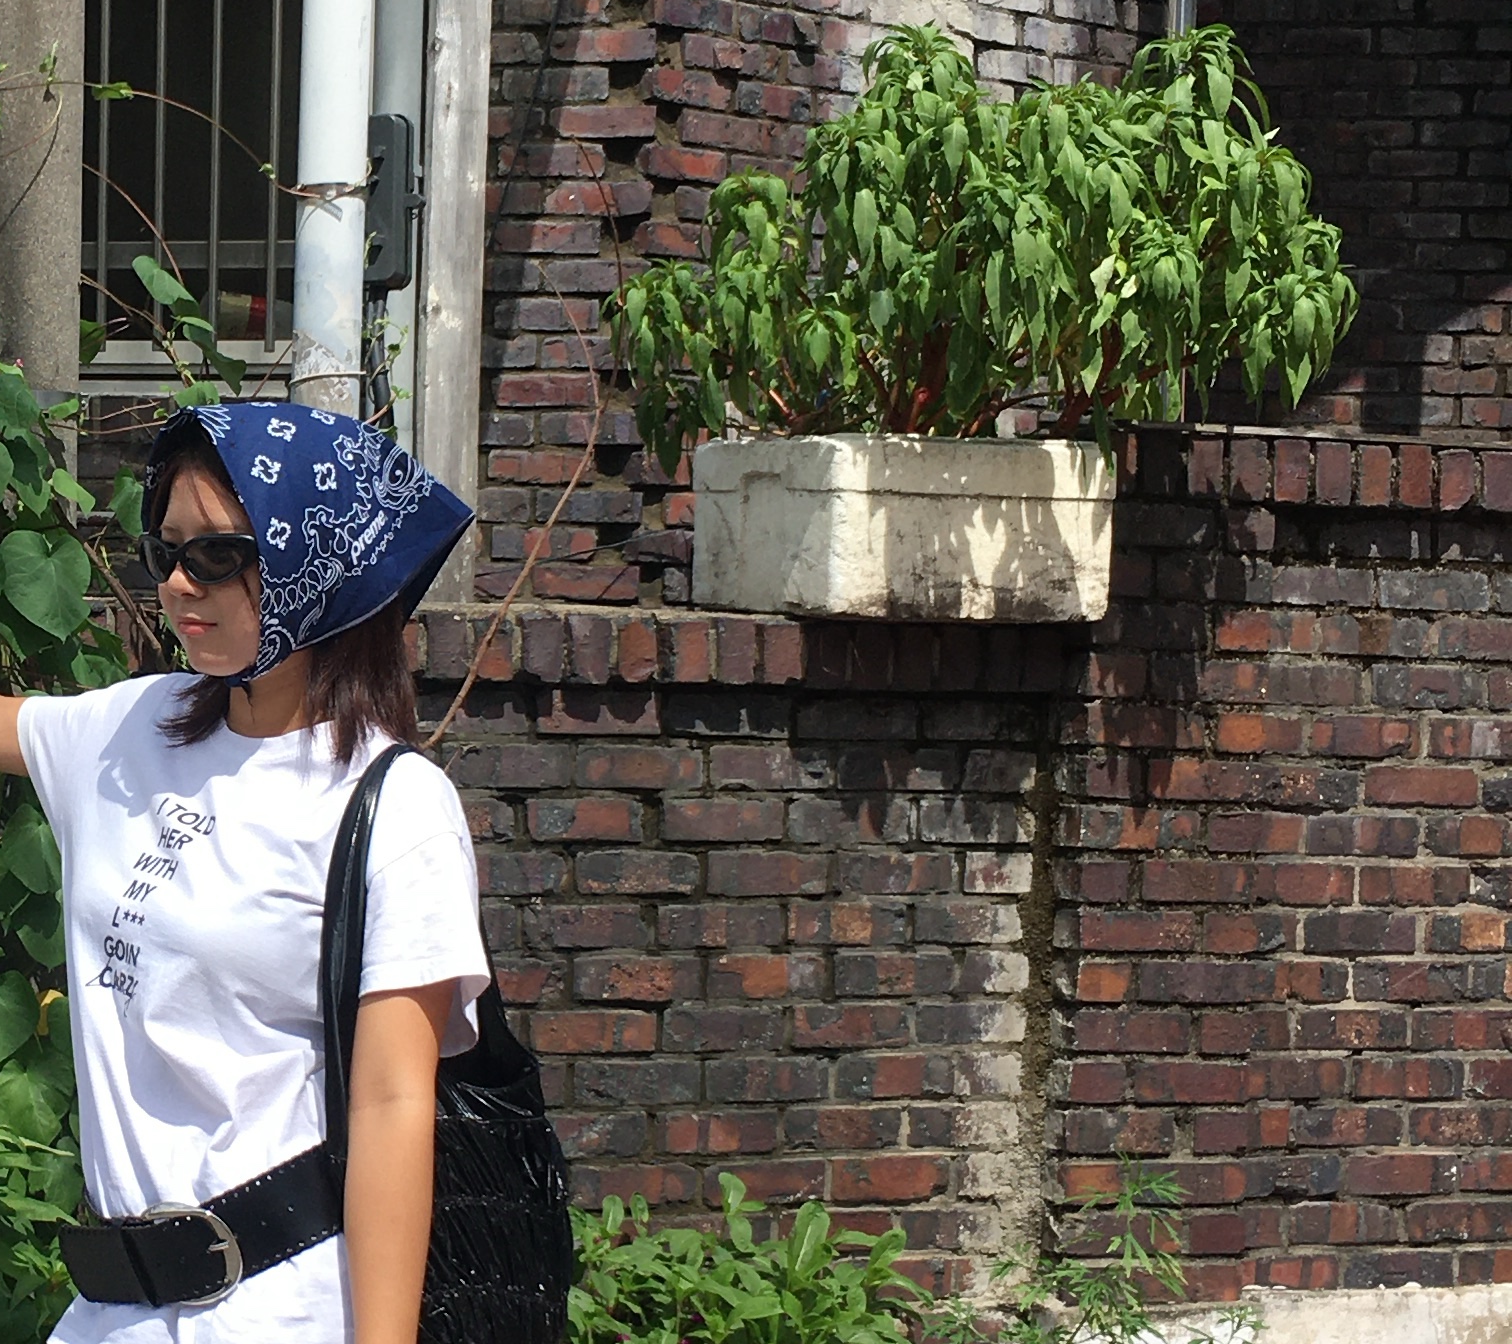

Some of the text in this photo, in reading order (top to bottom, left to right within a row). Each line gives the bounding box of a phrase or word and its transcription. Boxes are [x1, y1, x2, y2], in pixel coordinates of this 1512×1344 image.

[156, 797, 216, 836] I TOLD
[157, 826, 193, 850] HER
[133, 852, 179, 880] WITH
[123, 879, 157, 902] MY
[103, 935, 140, 967] GOIN
